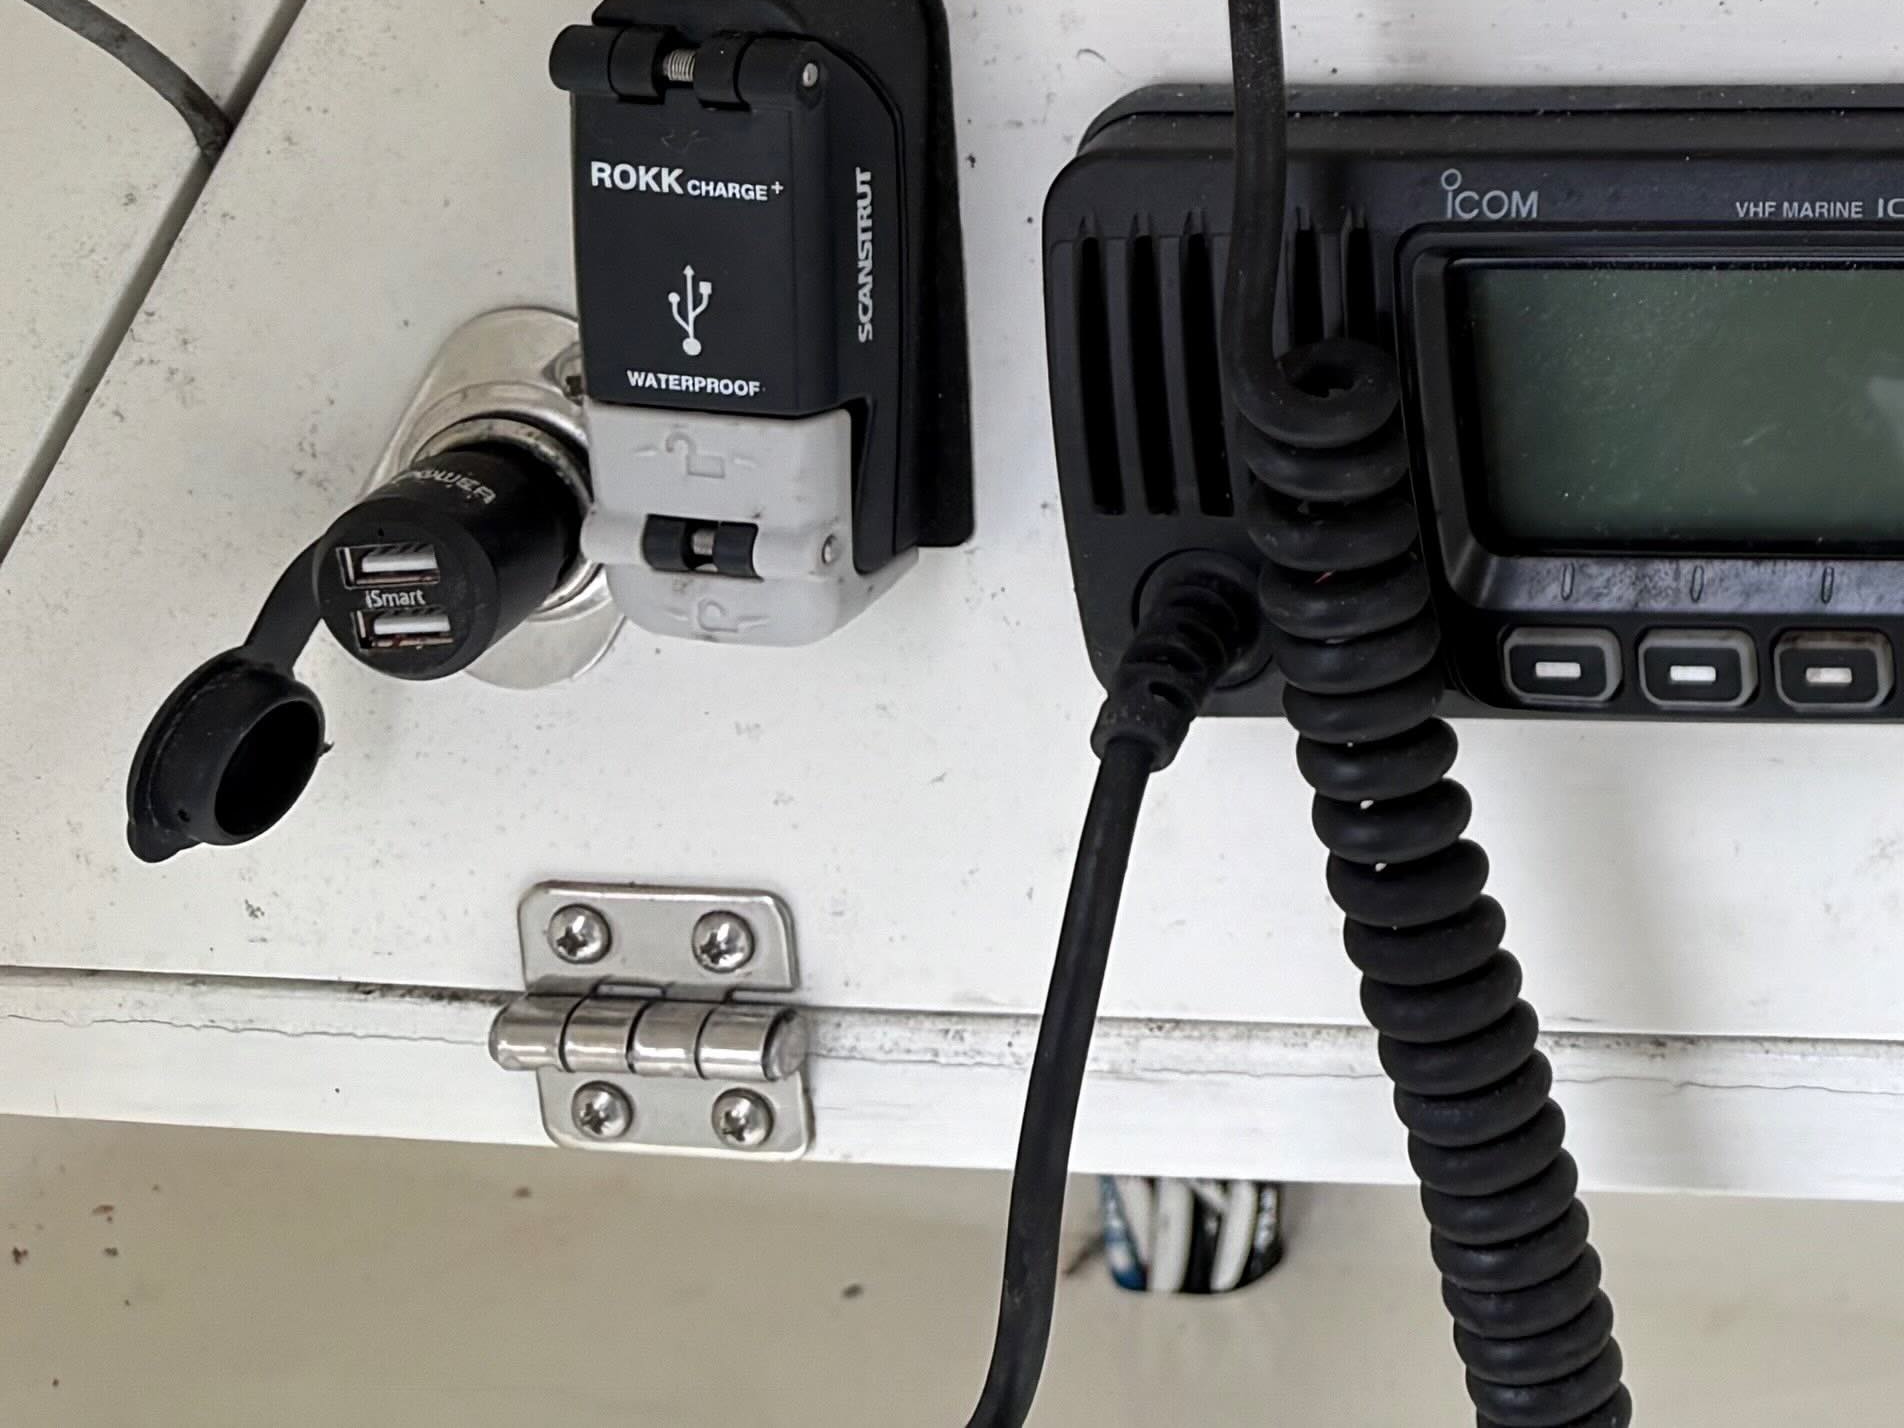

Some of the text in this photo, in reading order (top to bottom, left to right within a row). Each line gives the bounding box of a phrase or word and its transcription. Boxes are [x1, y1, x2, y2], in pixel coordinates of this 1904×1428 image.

[591, 161, 684, 195] ROKK
[1735, 201, 1777, 218] VHF
[1782, 201, 1864, 219] MARINE
[855, 166, 873, 343] SCANSTRUT
[626, 370, 761, 397] WATERPROOF
[365, 589, 426, 609] iSmart
